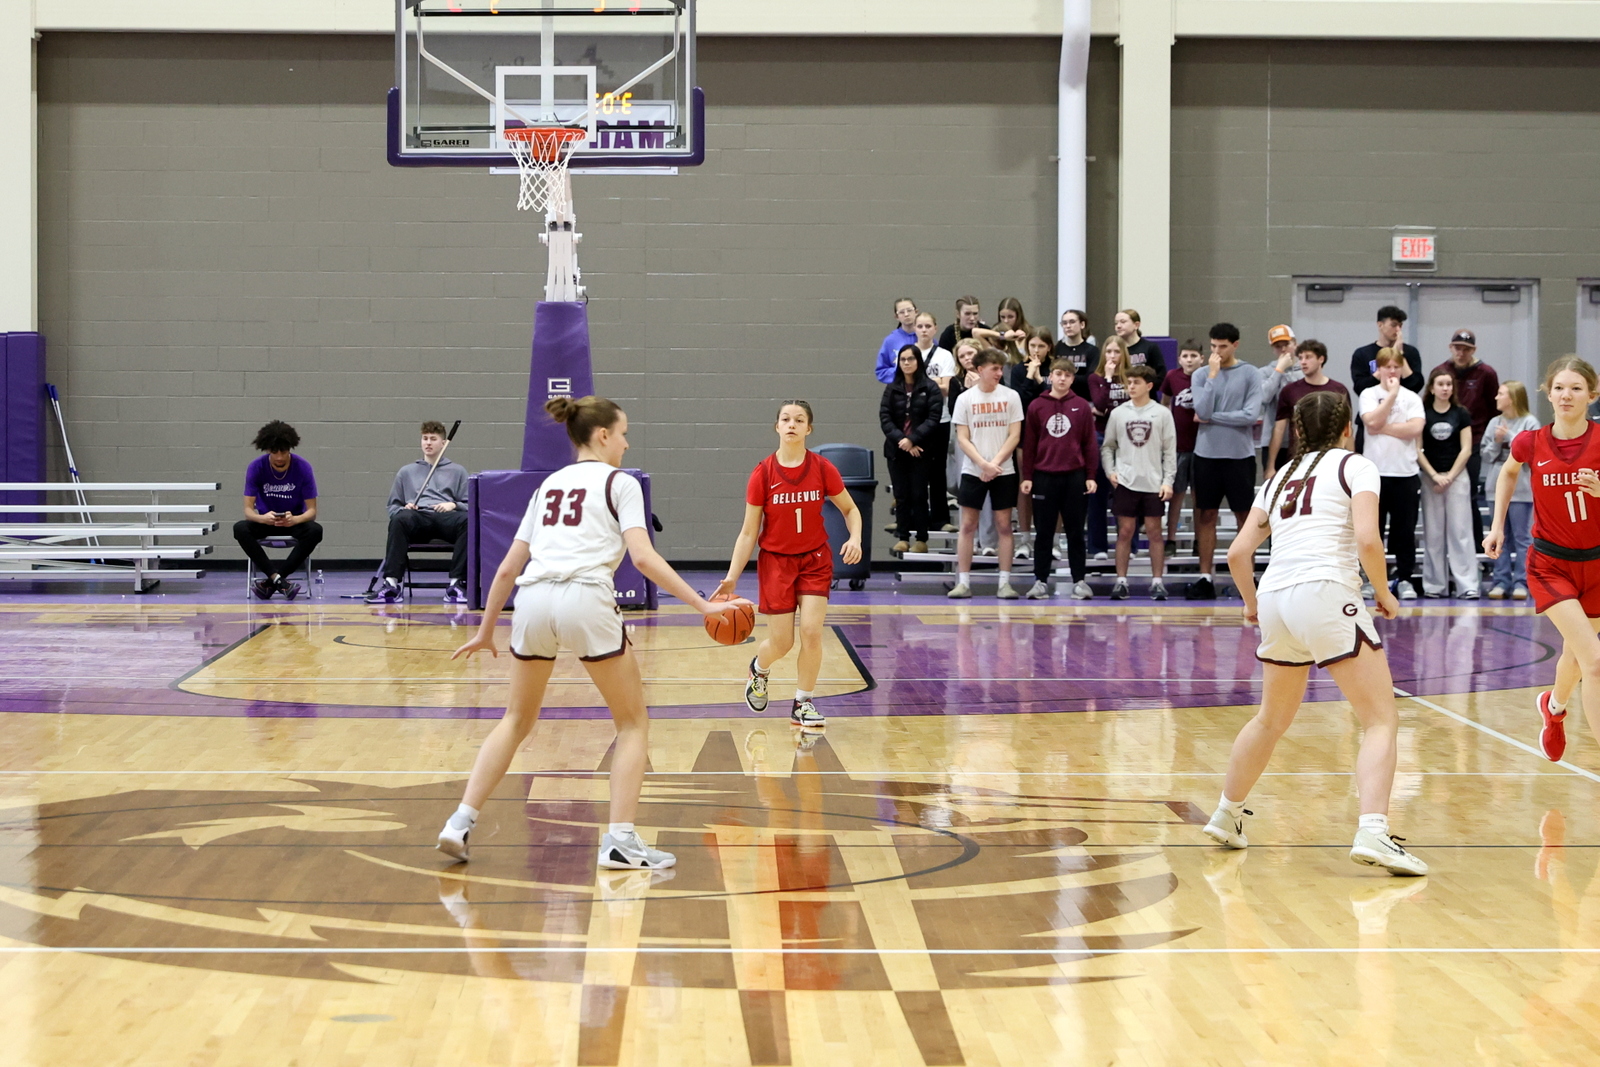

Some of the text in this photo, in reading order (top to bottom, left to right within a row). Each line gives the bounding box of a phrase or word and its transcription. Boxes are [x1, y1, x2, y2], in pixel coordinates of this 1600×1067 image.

[1401, 238, 1428, 258] EXIT
[971, 401, 1009, 415] FINDLAY
[542, 488, 587, 527] 33
[772, 490, 821, 505] BELLEVUE
[1280, 475, 1317, 520] 31
[1564, 491, 1588, 523] 11
[794, 507, 803, 534] 1
[1342, 603, 1358, 617] G
